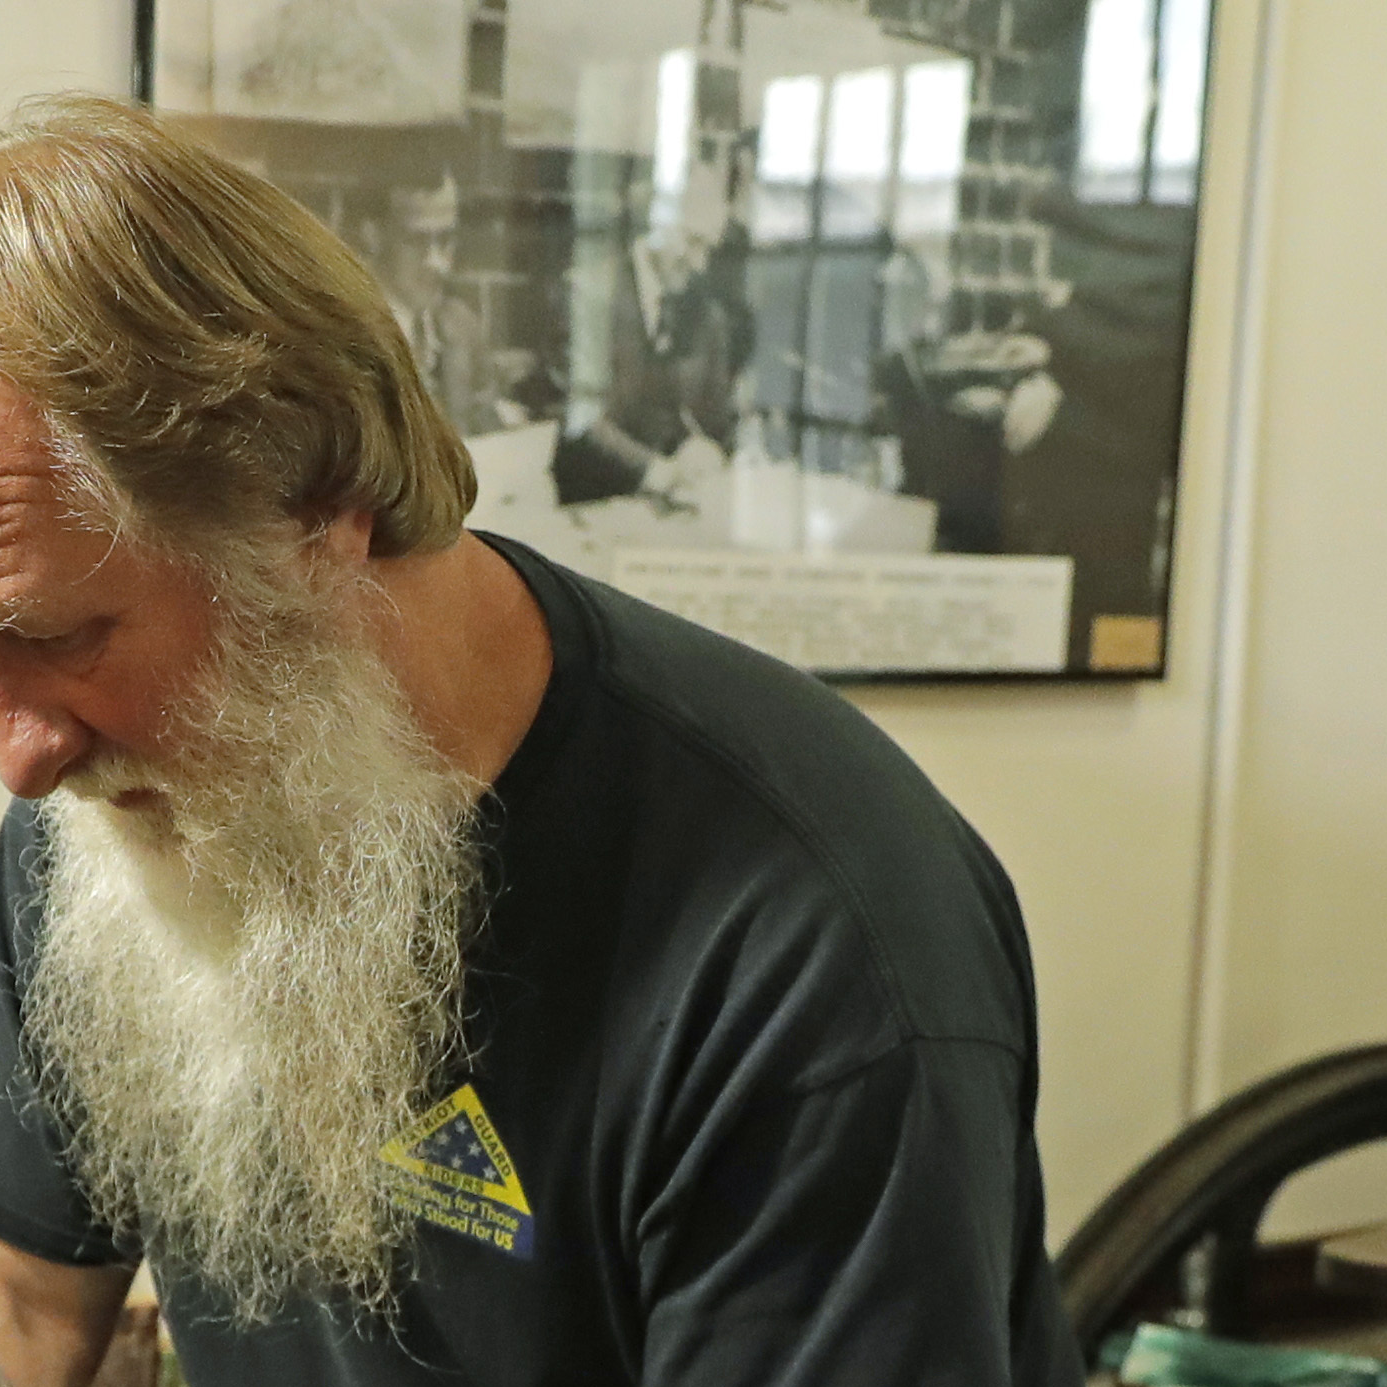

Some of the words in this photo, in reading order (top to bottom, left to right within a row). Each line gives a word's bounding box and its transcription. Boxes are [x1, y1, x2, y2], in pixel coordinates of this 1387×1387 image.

[473, 1114, 512, 1178] GUARD
[424, 1204, 469, 1234] Stood
[471, 1221, 493, 1241] for
